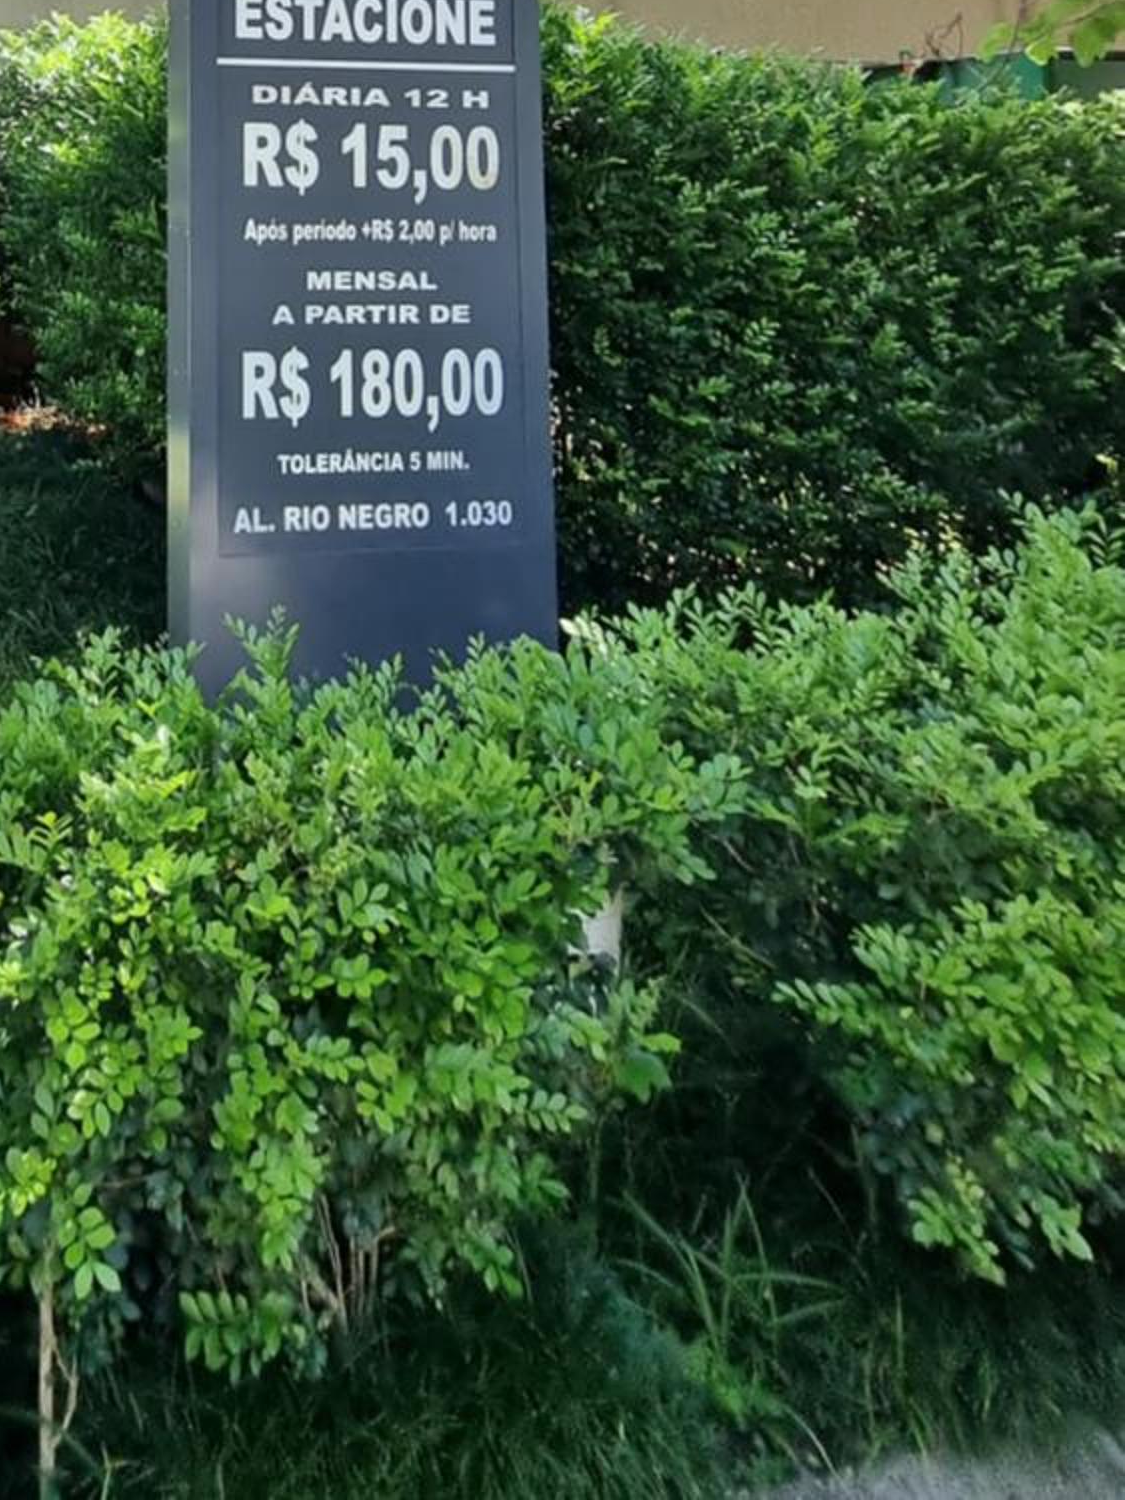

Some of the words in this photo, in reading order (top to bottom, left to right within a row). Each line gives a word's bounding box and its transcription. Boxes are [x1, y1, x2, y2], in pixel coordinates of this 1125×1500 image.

[252, 81, 390, 107] DIÁRIA
[404, 88, 449, 108] 12
[462, 90, 489, 109] H
[243, 118, 320, 196] R$
[341, 122, 500, 204] 15,00
[244, 218, 287, 246] Após
[361, 219, 394, 243] +R$
[399, 220, 435, 244] 2,00
[459, 220, 497, 241] hora
[306, 271, 438, 291] MENSAL
[272, 305, 295, 325] A
[305, 304, 420, 324] PARTIR
[429, 304, 471, 324] DE
[242, 346, 310, 428] R$
[330, 348, 504, 433] 180,00
[278, 448, 404, 474] TOLERÂNCIA
[409, 451, 421, 471] 5
[426, 451, 470, 470] MIN.
[234, 507, 275, 533] AL.
[284, 505, 329, 531] RIO
[338, 503, 430, 529] NEGRO
[445, 500, 513, 527] 1.030
